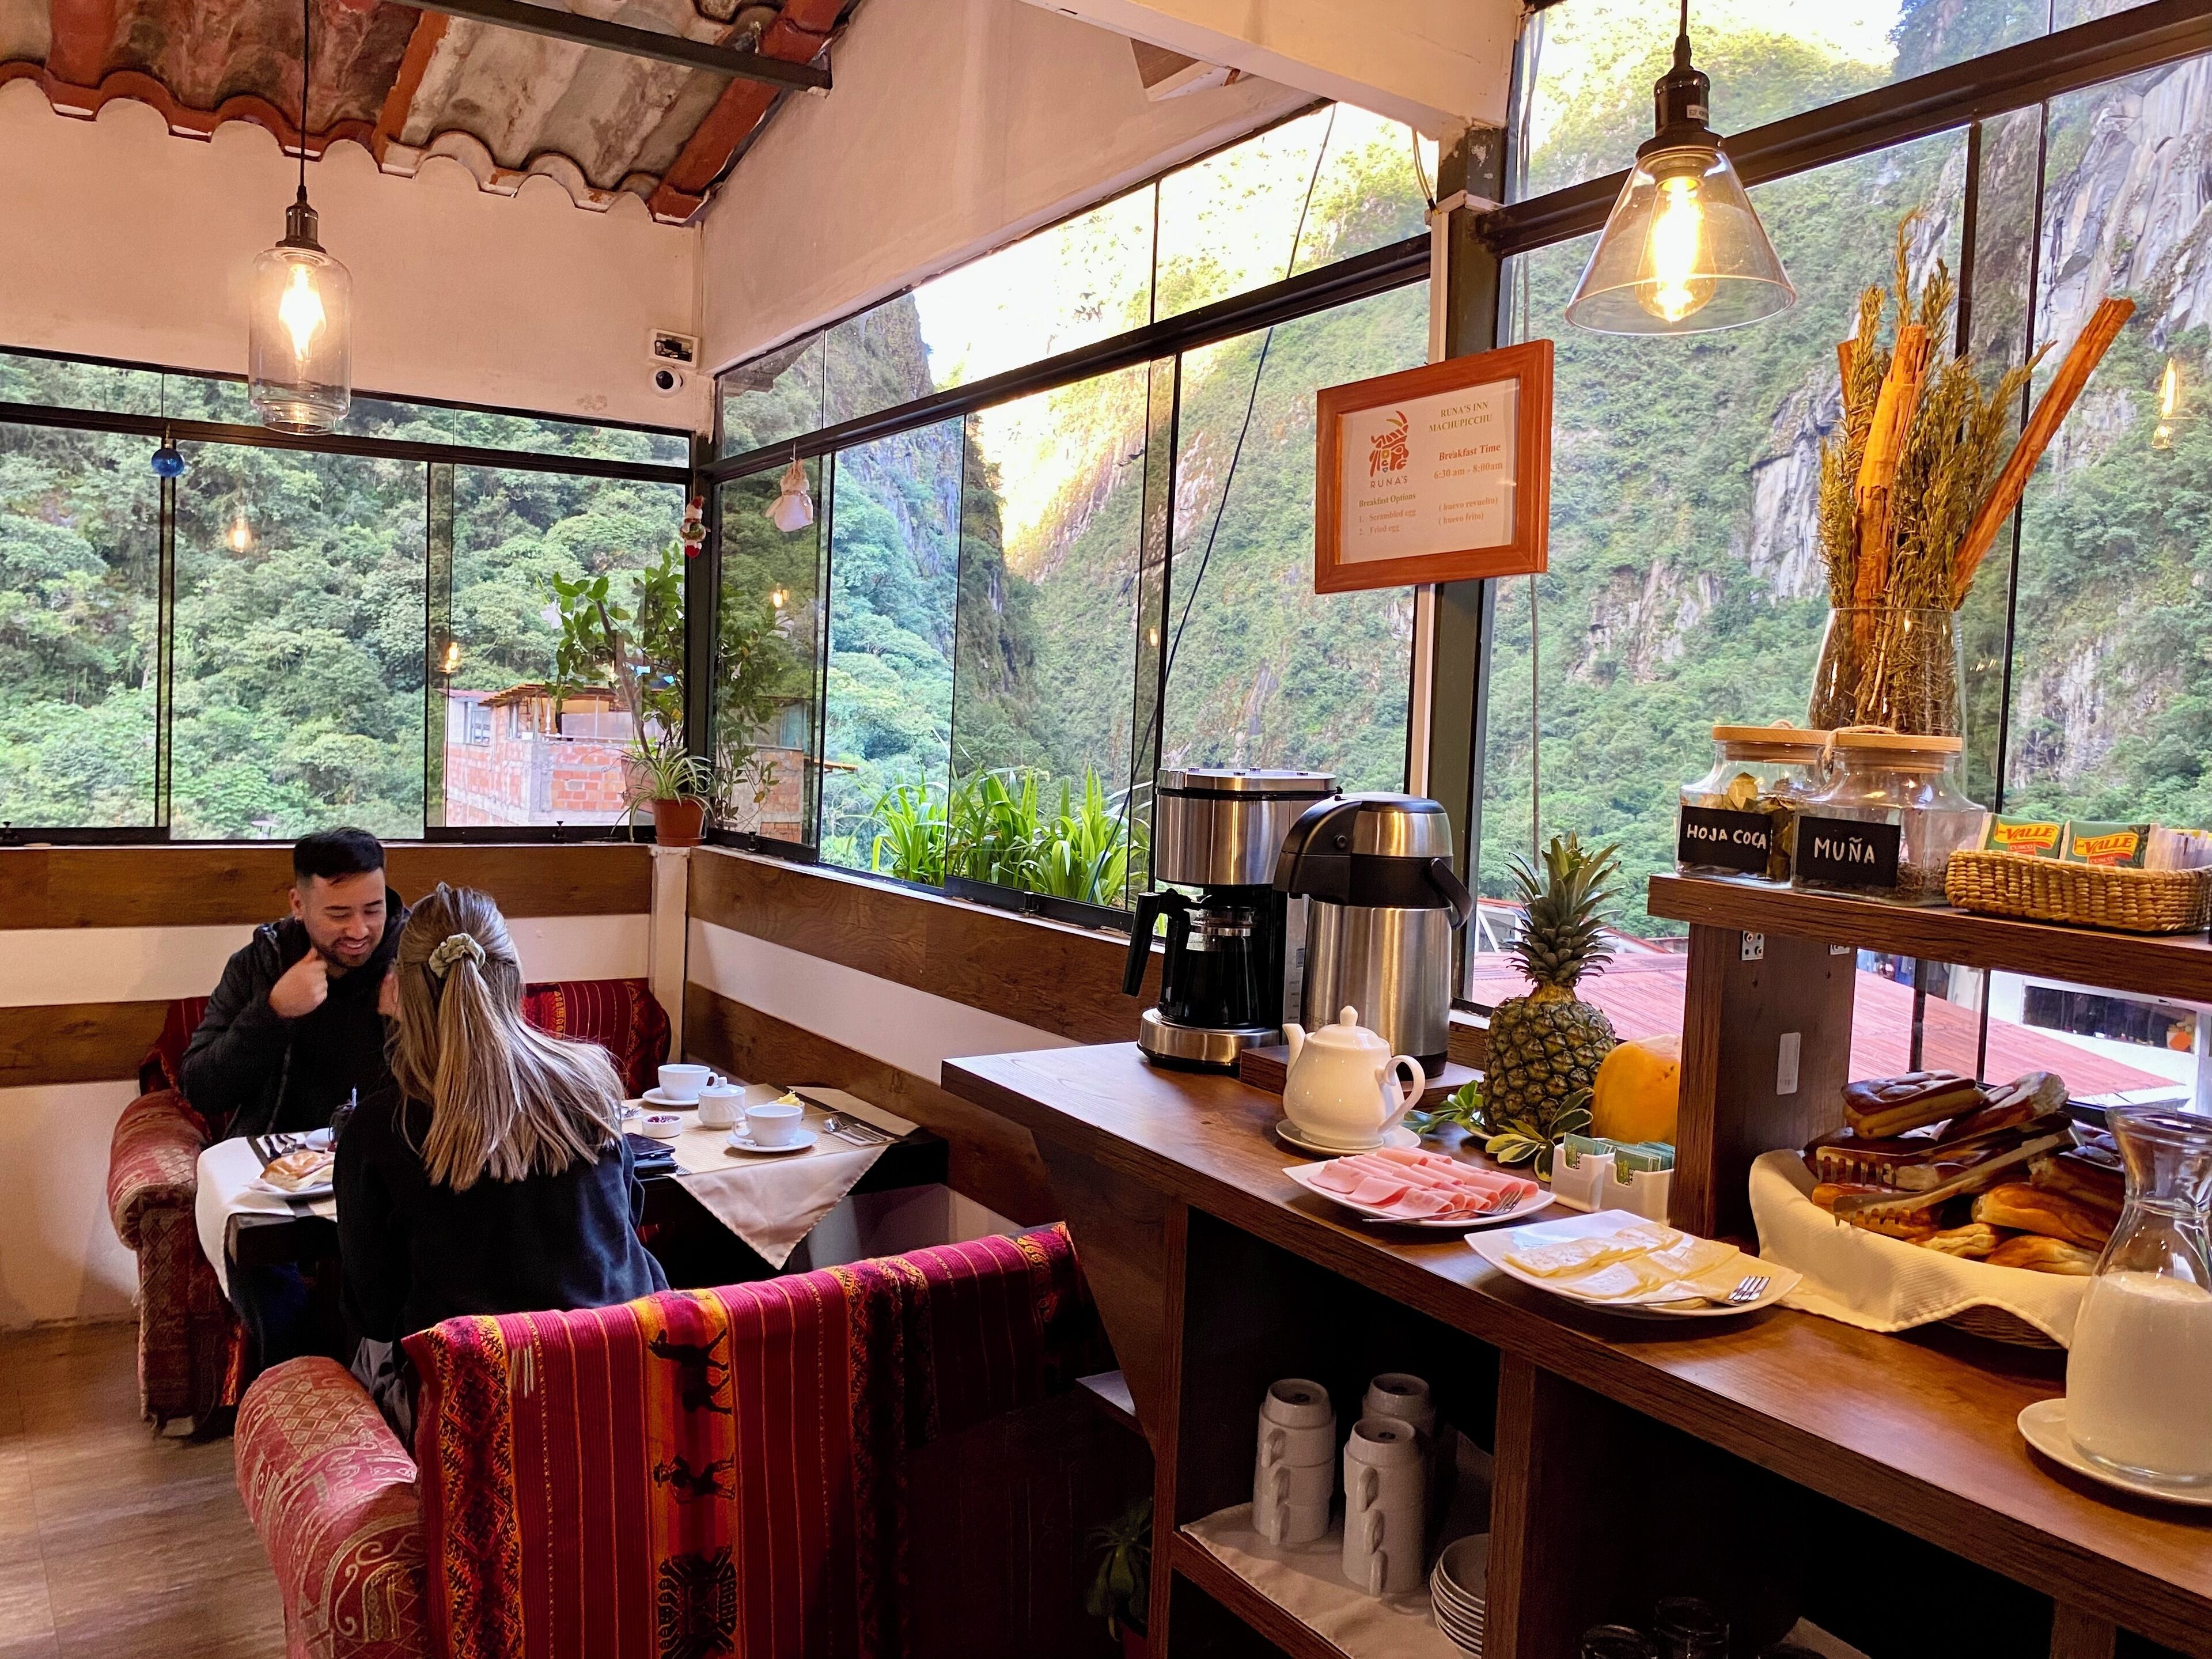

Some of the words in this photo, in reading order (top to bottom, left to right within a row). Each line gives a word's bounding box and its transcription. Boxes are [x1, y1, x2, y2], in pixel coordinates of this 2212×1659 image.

[1441, 404, 1471, 418] RUNA'S
[1474, 402, 1488, 411] INN
[1429, 414, 1492, 432] MACHUPICCHU
[1440, 448, 1477, 461] Breakfast
[1480, 444, 1501, 453] Time
[1434, 469, 1450, 479] 6:30
[1473, 462, 1502, 473] 8:00am
[1370, 476, 1408, 488] RUNA'S
[1359, 497, 1388, 507] Breakfast
[1391, 493, 1415, 503] Options
[1369, 510, 1403, 521] Scrambled
[1405, 509, 1416, 517] egg
[1370, 525, 1387, 534] Fried
[1687, 824, 1728, 842] HOJA
[1733, 829, 1767, 850] COCA
[2006, 827, 2055, 840] VALLE
[1814, 837, 1875, 863] MUÑA
[2084, 837, 2134, 854] VALLE
